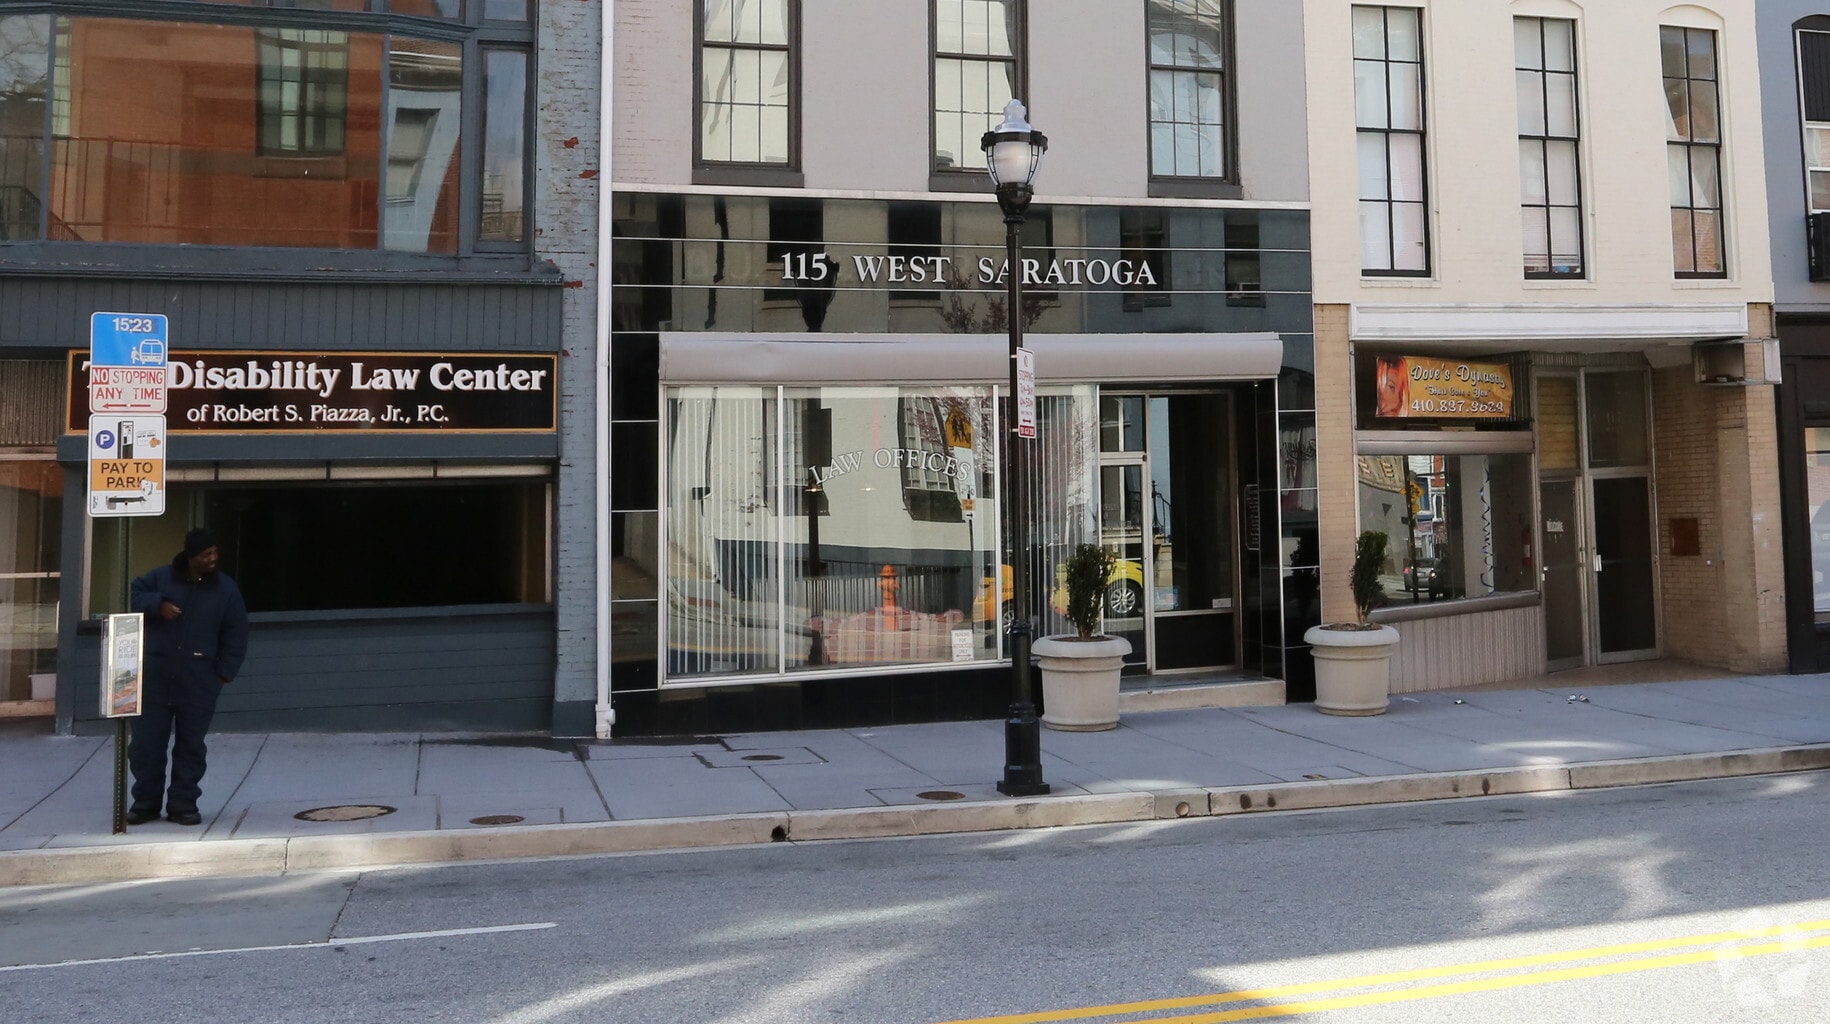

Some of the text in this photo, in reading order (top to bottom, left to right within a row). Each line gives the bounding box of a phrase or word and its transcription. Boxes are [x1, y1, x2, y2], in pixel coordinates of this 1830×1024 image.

[780, 252, 828, 281] 115
[852, 255, 951, 283] WEST
[978, 256, 1157, 286] SARATOGA
[93, 369, 108, 383] NO
[113, 370, 163, 384] STOPPING
[167, 360, 547, 398] Disability Law Center
[1411, 362, 1451, 381] Dove's
[96, 387, 162, 400] ANY TIME
[186, 404, 450, 424] of Robert S. Piazza, Jr., P.C.
[101, 462, 153, 474] PAY TO
[809, 448, 971, 486] LAW OFFICES
